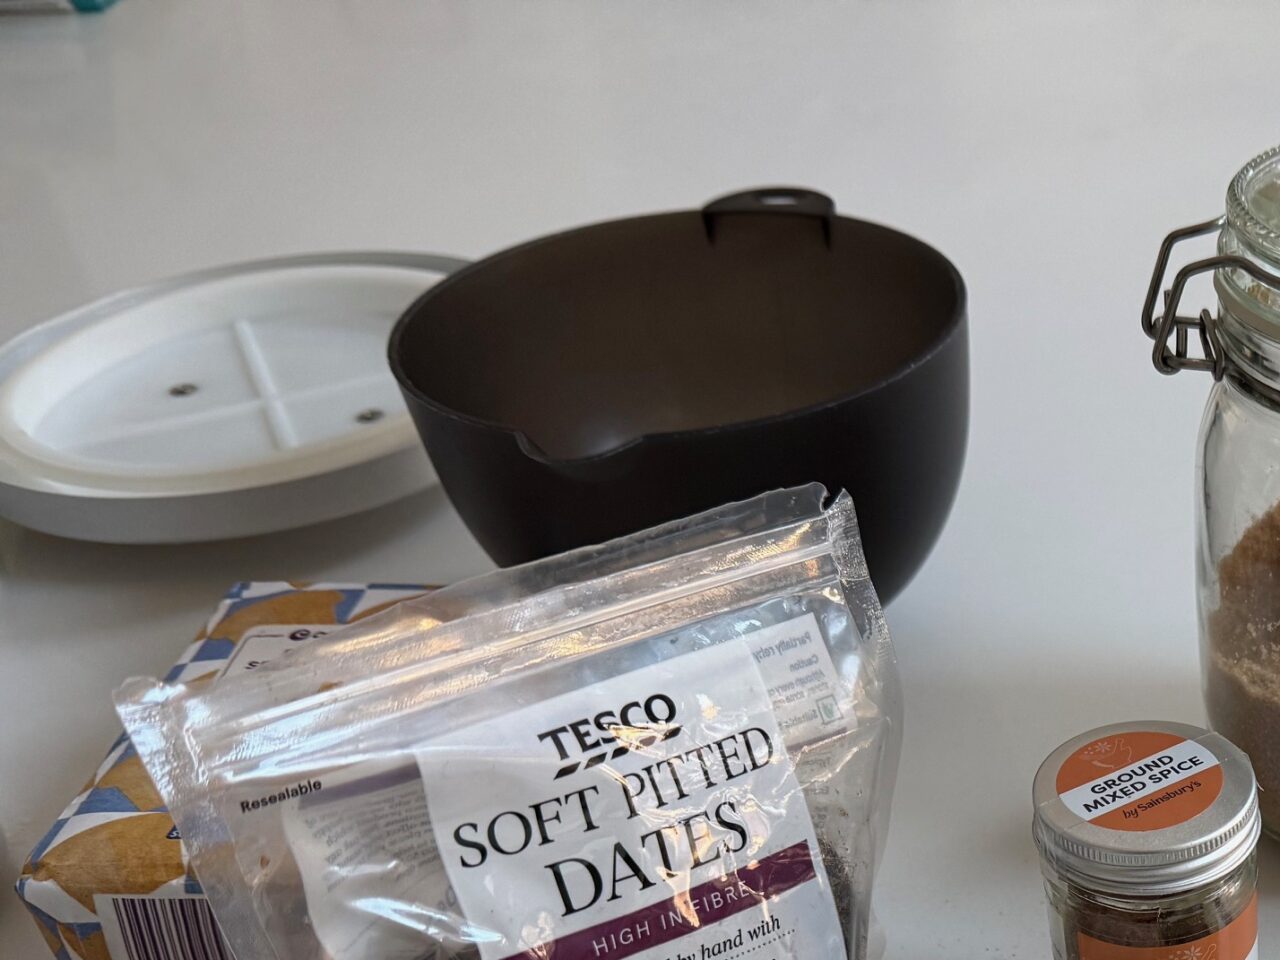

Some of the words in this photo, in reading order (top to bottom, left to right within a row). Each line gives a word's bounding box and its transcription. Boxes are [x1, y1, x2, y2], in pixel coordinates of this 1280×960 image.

[537, 693, 677, 761] TESCO
[240, 779, 322, 814] Resealable
[453, 785, 600, 869] SOFT
[621, 727, 775, 820] PITTED
[1083, 782, 1147, 813] MIXED
[1148, 755, 1204, 784] SPICE
[1091, 755, 1174, 795] GROUND
[1123, 808, 1139, 819] by
[1138, 780, 1202, 811] Sainsbury's
[544, 801, 748, 917] DATES
[592, 919, 651, 958] HIGH
[660, 910, 683, 932] IN
[691, 880, 752, 919] FIBRE
[747, 914, 781, 943] with
